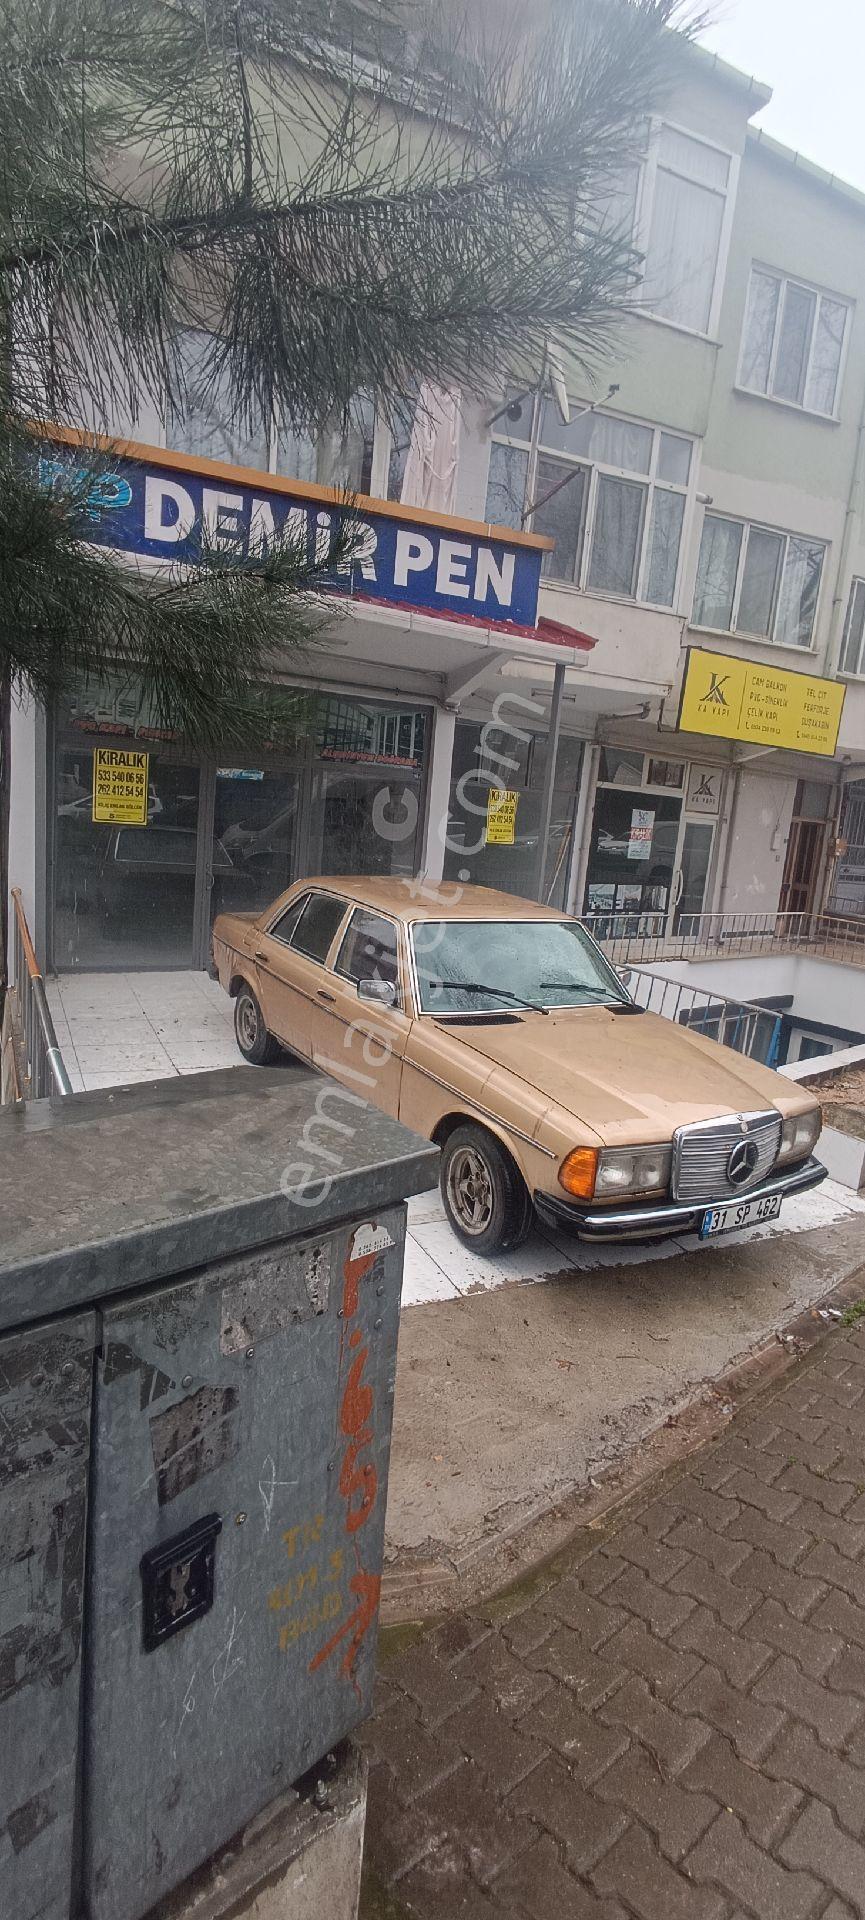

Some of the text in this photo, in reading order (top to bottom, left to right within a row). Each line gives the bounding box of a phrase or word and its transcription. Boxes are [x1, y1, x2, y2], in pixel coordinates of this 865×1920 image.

[393, 530, 516, 606] PEN
[752, 676, 765, 688] CAM
[697, 704, 730, 717] KA YAPI
[765, 711, 779, 721] KAPI
[98, 769, 145, 785] 533 540 06 56
[98, 783, 144, 799] 262 412 54 54
[711, 1210, 728, 1230] 31
[734, 1204, 751, 1225] SP
[756, 1197, 778, 1218] 462
